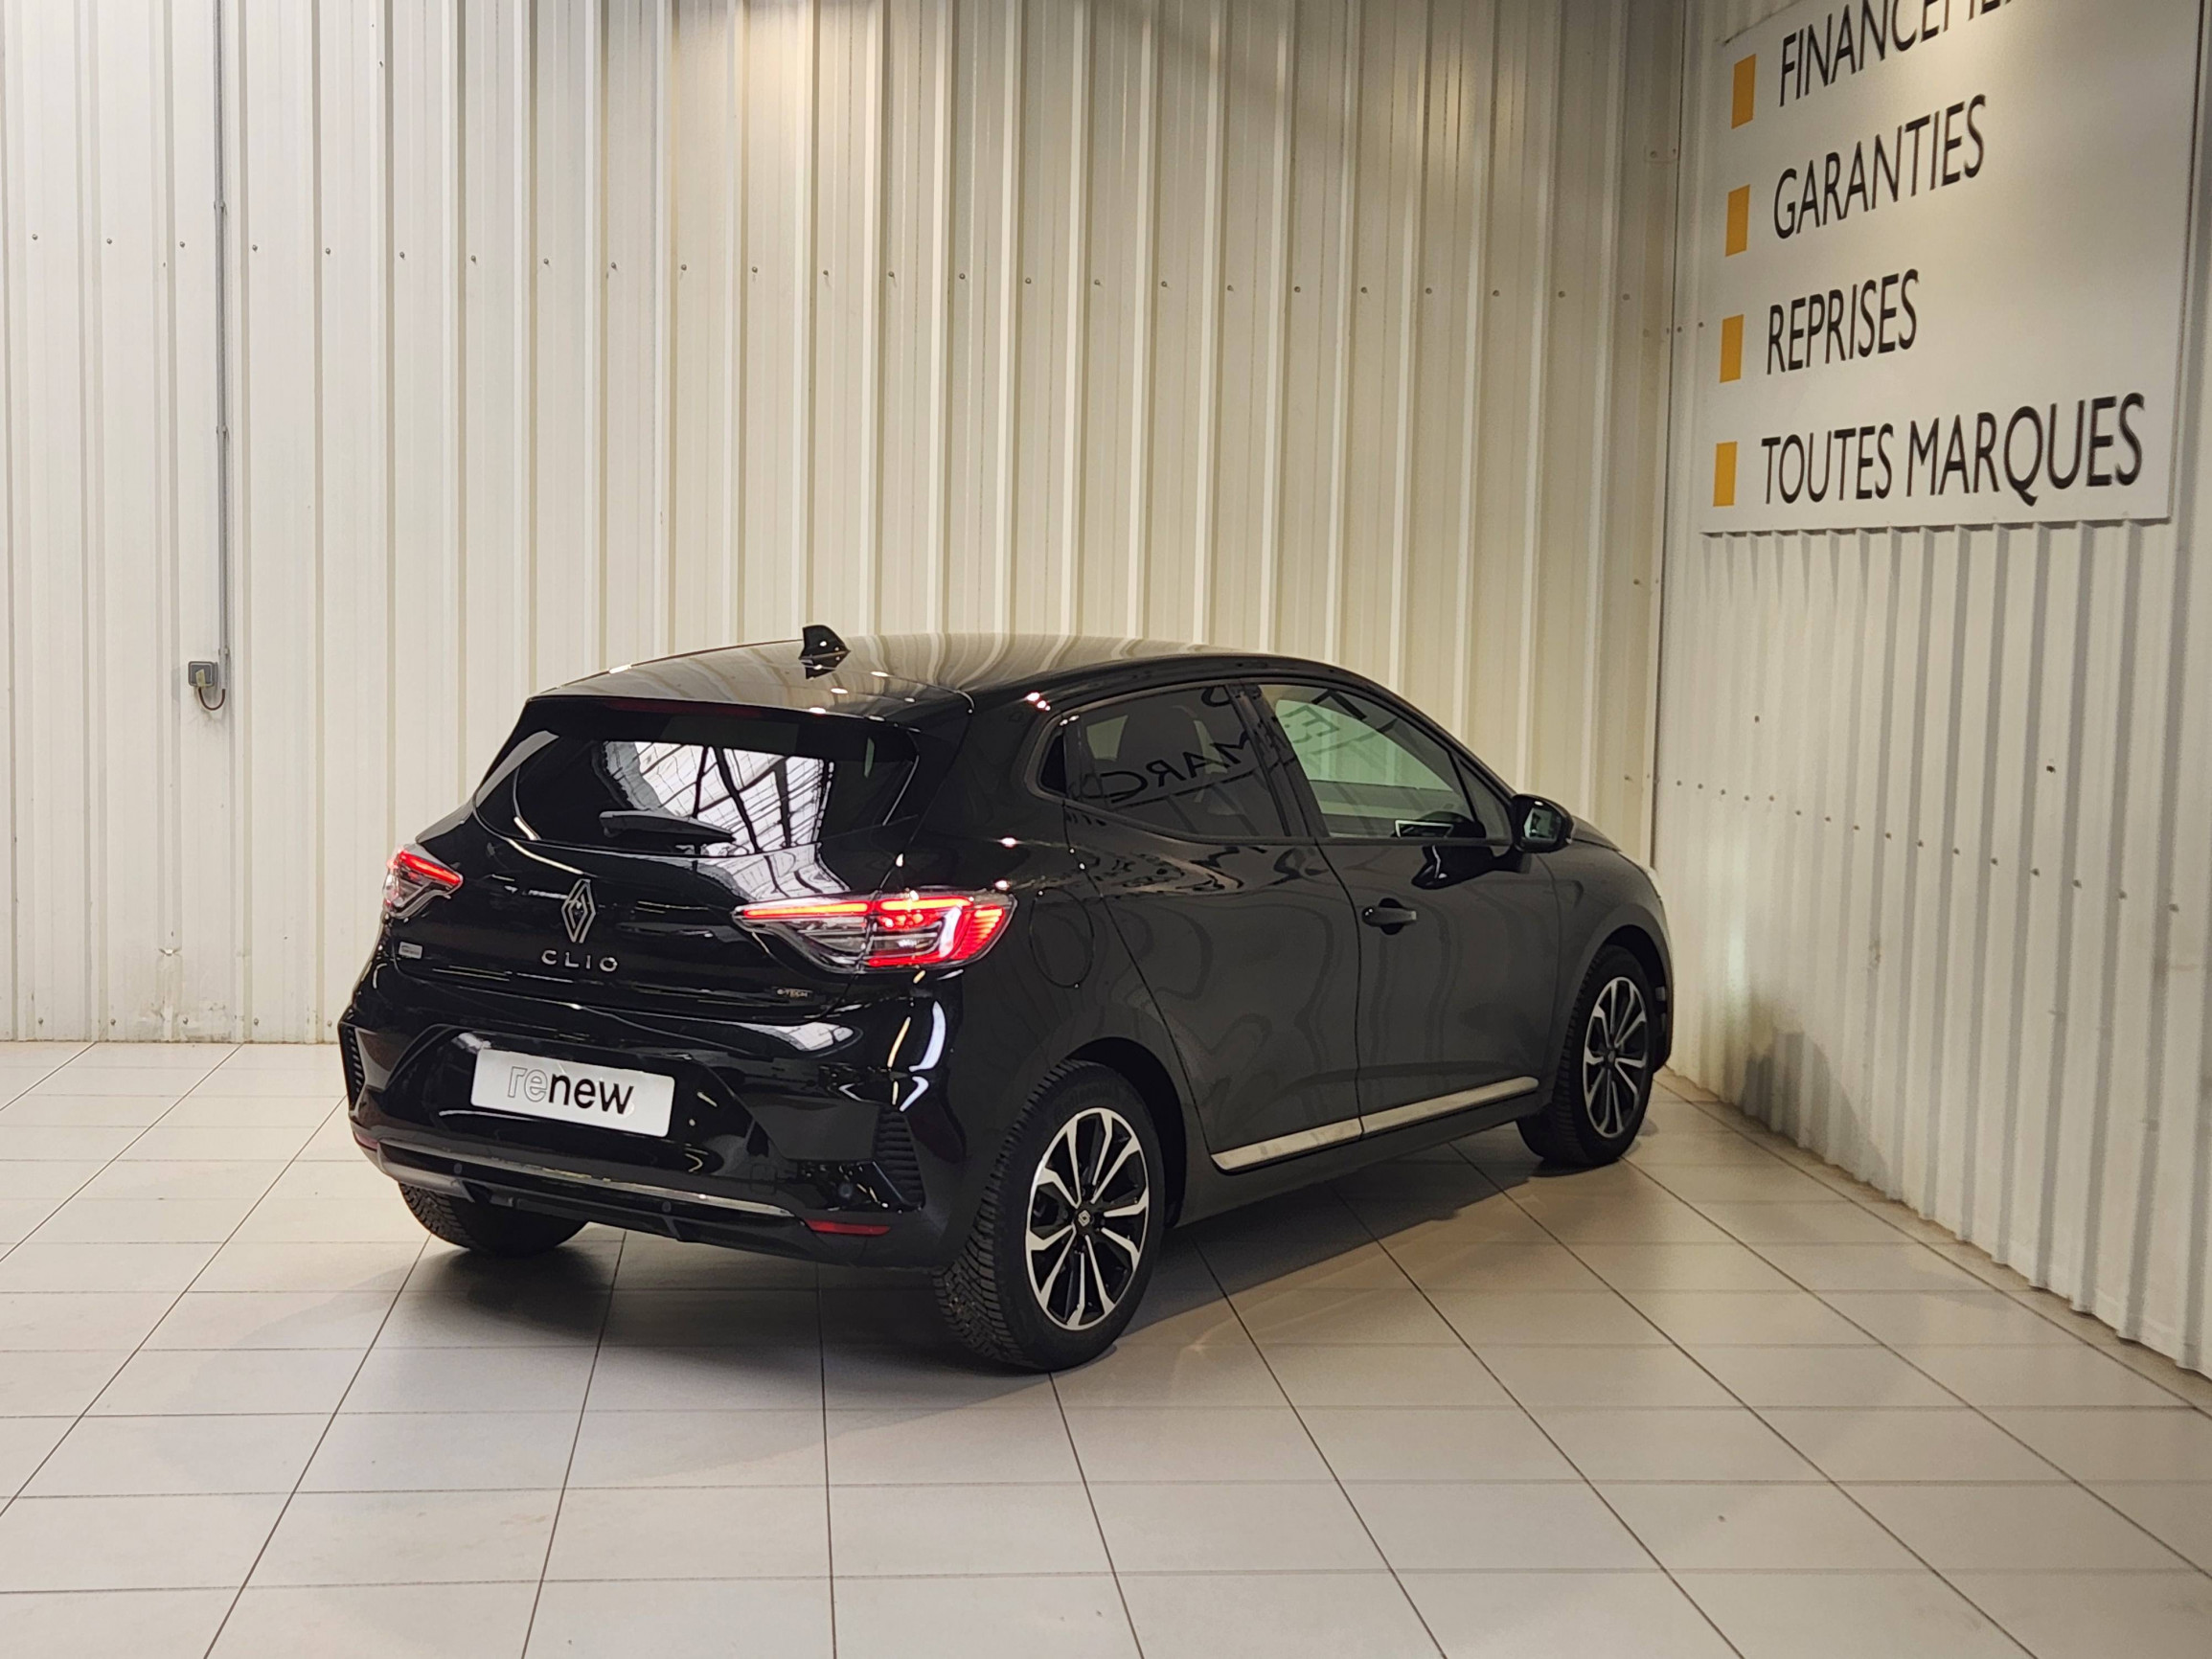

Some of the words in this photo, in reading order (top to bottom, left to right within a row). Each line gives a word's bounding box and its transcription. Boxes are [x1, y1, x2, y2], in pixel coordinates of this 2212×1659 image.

[1779, 0, 2013, 107] FINANCE
[1773, 94, 1986, 239] GARANTIES
[1767, 269, 1919, 375] REPRISES
[1761, 423, 1894, 505] TOUTES
[1906, 392, 2145, 507] MARQUES
[541, 950, 618, 972] CLIO
[508, 1065, 634, 1115] renew
